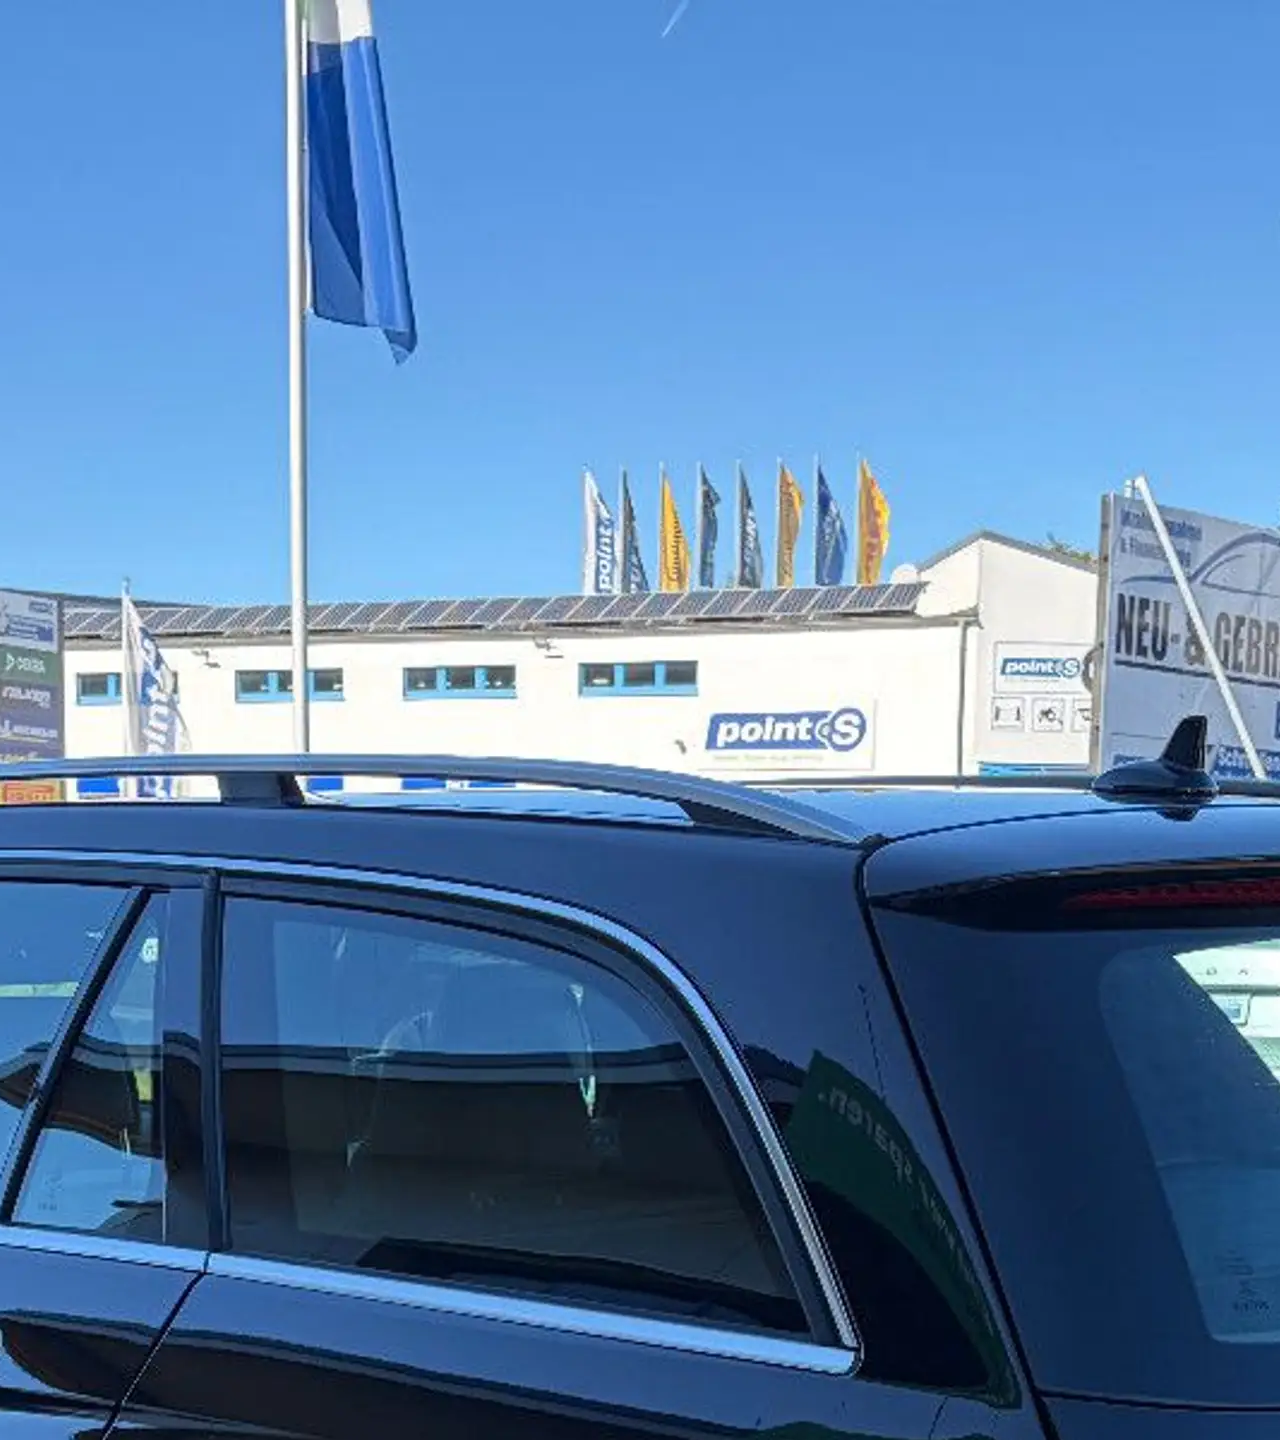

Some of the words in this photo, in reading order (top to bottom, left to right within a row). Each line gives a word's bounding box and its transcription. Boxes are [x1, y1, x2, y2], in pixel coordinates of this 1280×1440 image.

[1115, 593, 1180, 662] NEU-
[1005, 659, 1057, 674] point
[1063, 659, 1079, 677] S
[716, 715, 813, 748] point
[831, 711, 862, 747] S
